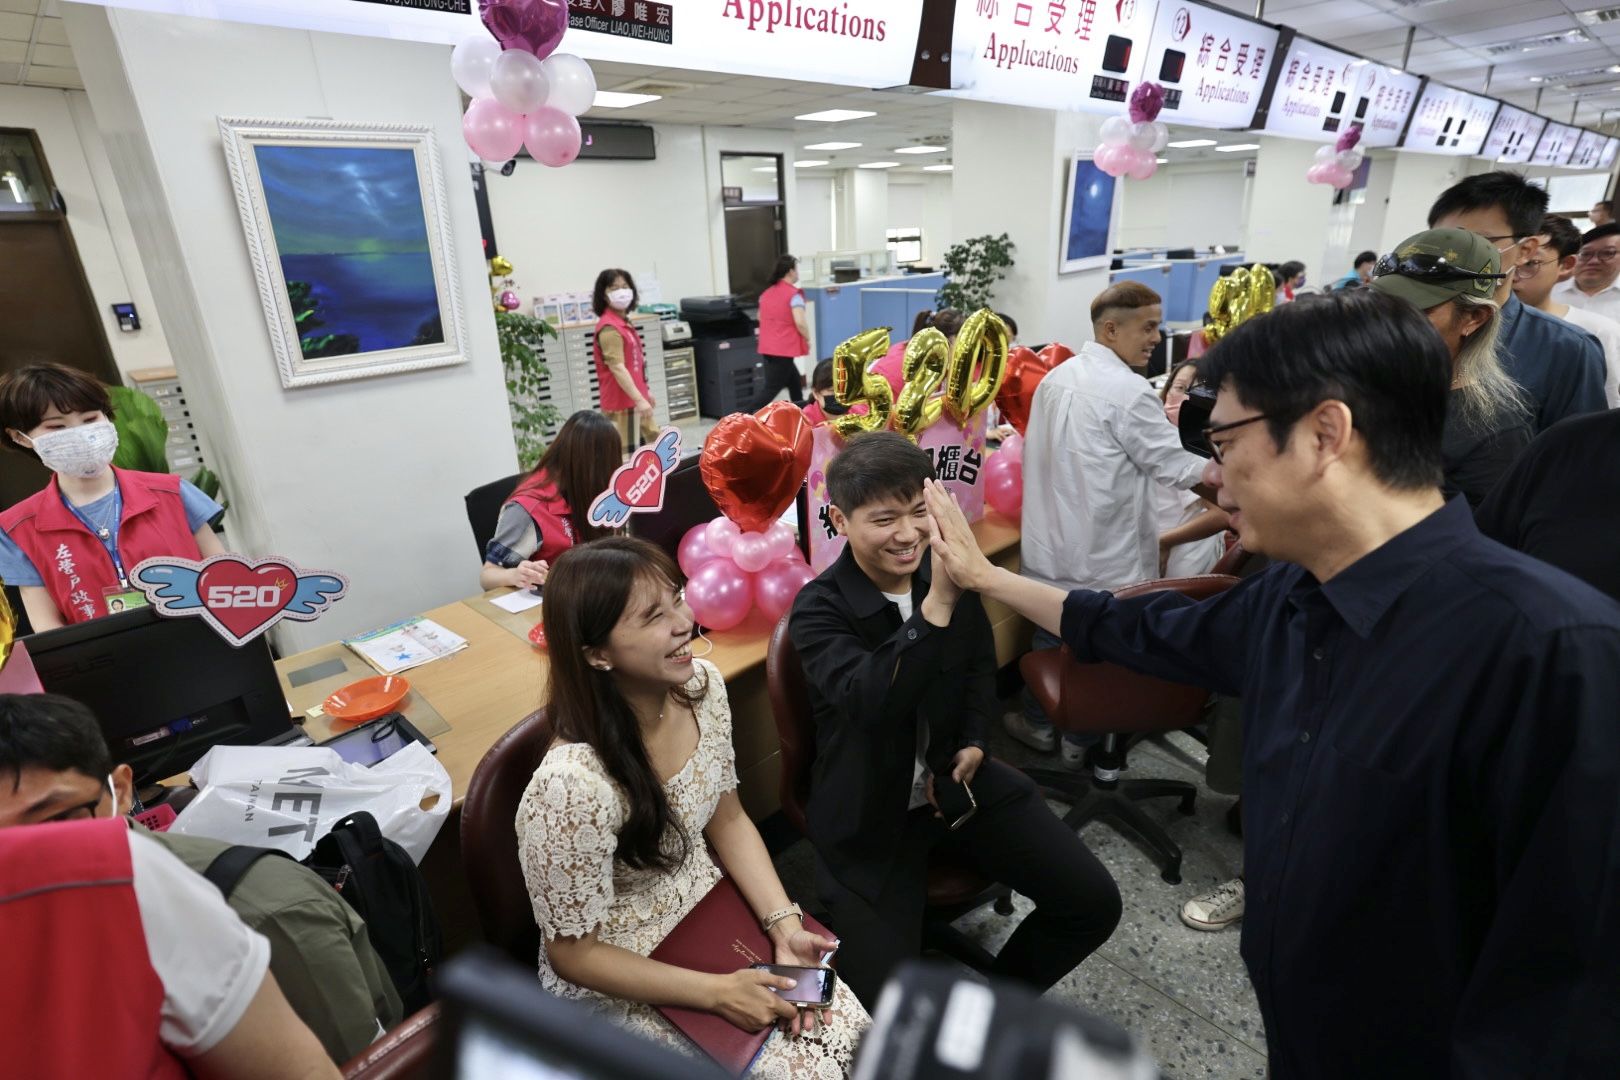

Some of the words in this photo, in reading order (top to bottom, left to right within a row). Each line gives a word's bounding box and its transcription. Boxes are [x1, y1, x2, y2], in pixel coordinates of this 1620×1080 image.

[568, 13, 583, 27] ase
[584, 15, 609, 31] Officer
[610, 20, 670, 42] LIAO,WEI-HUNG
[983, 32, 1080, 74] Applications
[1196, 32, 1266, 79] 綜合受理
[1195, 76, 1251, 104] Applications
[625, 463, 660, 505] 520
[924, 445, 981, 485] 櫃台
[207, 585, 281, 608] 520
[268, 766, 330, 843] NET
